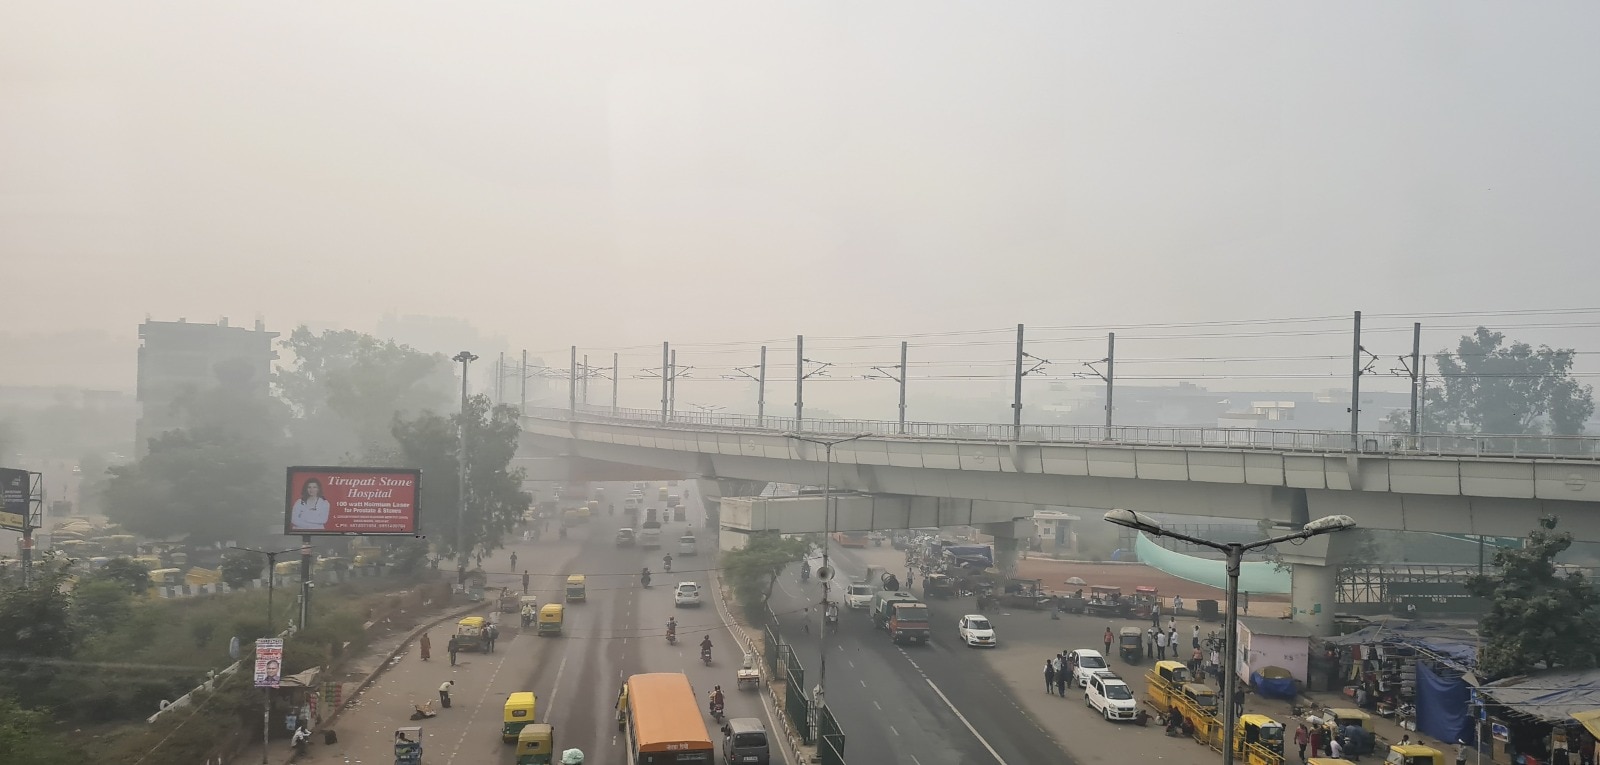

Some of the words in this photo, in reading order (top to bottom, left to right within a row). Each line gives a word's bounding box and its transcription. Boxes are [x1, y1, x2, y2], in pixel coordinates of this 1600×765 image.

[327, 476, 376, 487] Tirupati
[379, 476, 412, 487] Stone
[347, 488, 392, 499] Hospital
